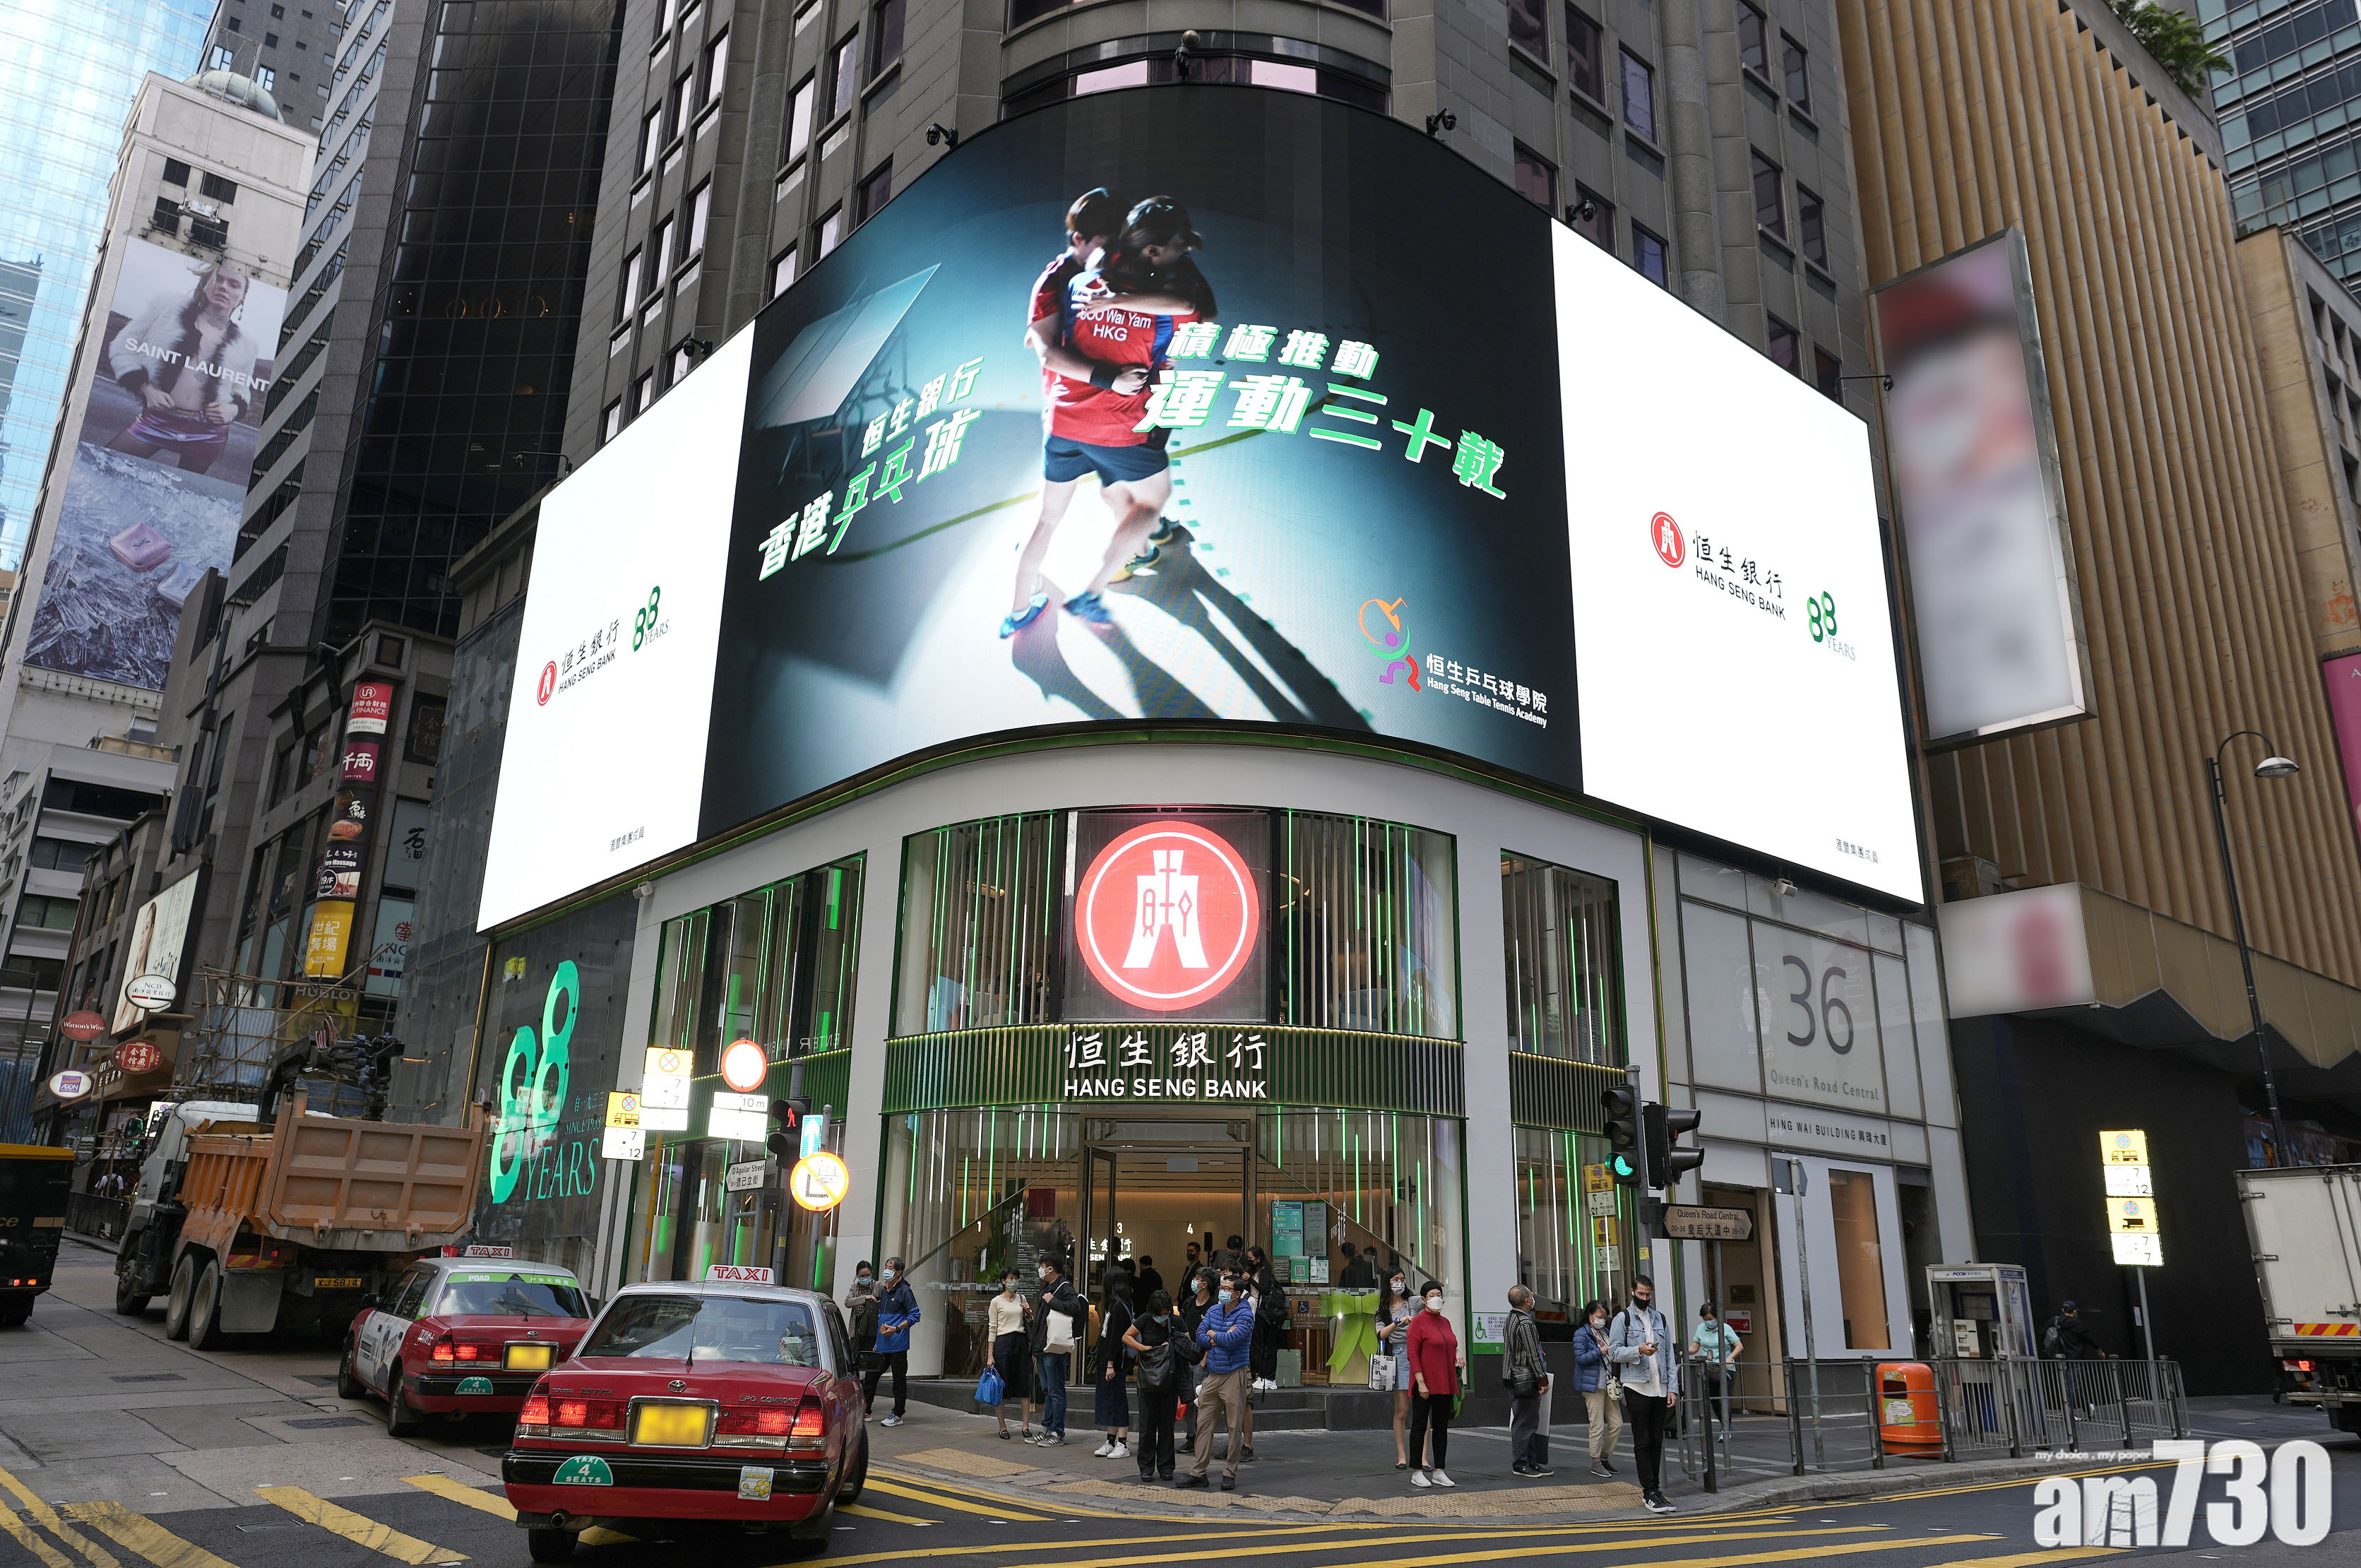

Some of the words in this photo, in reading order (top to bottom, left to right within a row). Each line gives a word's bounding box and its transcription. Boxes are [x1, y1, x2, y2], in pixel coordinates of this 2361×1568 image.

[1106, 309, 1126, 325] Wai
[1128, 312, 1152, 329] Yam
[1093, 323, 1129, 342] HKG
[1165, 321, 1379, 380] 積極推動
[124, 337, 182, 364] SAINT
[183, 355, 270, 393] LAURENT
[860, 355, 985, 459] 恒生銀行
[1131, 369, 1507, 500] 運動三十載
[758, 407, 984, 581] 香港乒乓球
[1693, 530, 1783, 599] 恒生銀行
[1696, 564, 1725, 590] HANG
[1728, 581, 1756, 605] SENG
[1759, 596, 1786, 621] BANK
[632, 586, 661, 652] 88
[1807, 590, 1837, 643] 88
[644, 619, 670, 646] YEARS
[561, 618, 620, 676] 恒生銀行
[1825, 634, 1856, 661] YEARS
[558, 673, 577, 695] HANG
[578, 661, 595, 682] SENG
[597, 647, 617, 670] BANK
[1426, 653, 1548, 714] 恒生乒乓球學院
[355, 707, 387, 716] FINANCE
[1427, 677, 1449, 695] Hang
[1450, 683, 1470, 701] Seng
[1471, 690, 1492, 707] Table
[1492, 698, 1516, 716] Tennis
[1516, 707, 1547, 729] Academy
[313, 920, 340, 936] 世紀
[310, 937, 338, 952] 廣場
[295, 985, 358, 1002] HUBLOT
[1783, 955, 1854, 1055] 36
[63, 1021, 90, 1030] Watson's
[1064, 1031, 1267, 1070] 恒生銀行
[490, 960, 580, 1204] 88
[674, 1079, 682, 1088] 7
[1064, 1079, 1125, 1097] HANG
[1132, 1078, 1196, 1097] SENG
[1205, 1079, 1267, 1099] BANK
[1770, 1069, 1809, 1089] Queen's
[1814, 1076, 1838, 1094] Road
[1843, 1082, 1879, 1101] Central
[672, 1095, 679, 1105] 7
[742, 1098, 754, 1107] 10
[564, 1119, 585, 1135] SINCE
[1770, 1117, 1792, 1132] HING
[1797, 1122, 1812, 1134] WAI
[1816, 1124, 1856, 1141] BUILDING
[631, 1131, 637, 1141] 7
[629, 1148, 641, 1158] 12
[525, 1137, 599, 1201] YEARS
[732, 1166, 750, 1175] D'Aguilar
[751, 1164, 765, 1172] Street
[2133, 1168, 2139, 1177] 7
[2136, 1184, 2149, 1194] 12
[1677, 1208, 1701, 1219] Queen's
[1701, 1211, 1718, 1220] Road
[1718, 1211, 1739, 1220] Central
[1117, 1222, 1123, 1234] 3
[1187, 1223, 1194, 1235] 4
[1688, 1224, 1730, 1237] 皇后大道中
[2142, 1236, 2148, 1245] 7
[470, 1247, 511, 1257] TAXI
[2144, 1252, 2151, 1262] 7
[713, 1266, 769, 1281] TAXI
[472, 1380, 480, 1389] 4
[574, 1456, 599, 1466] TAXI
[576, 1463, 590, 1477] 4
